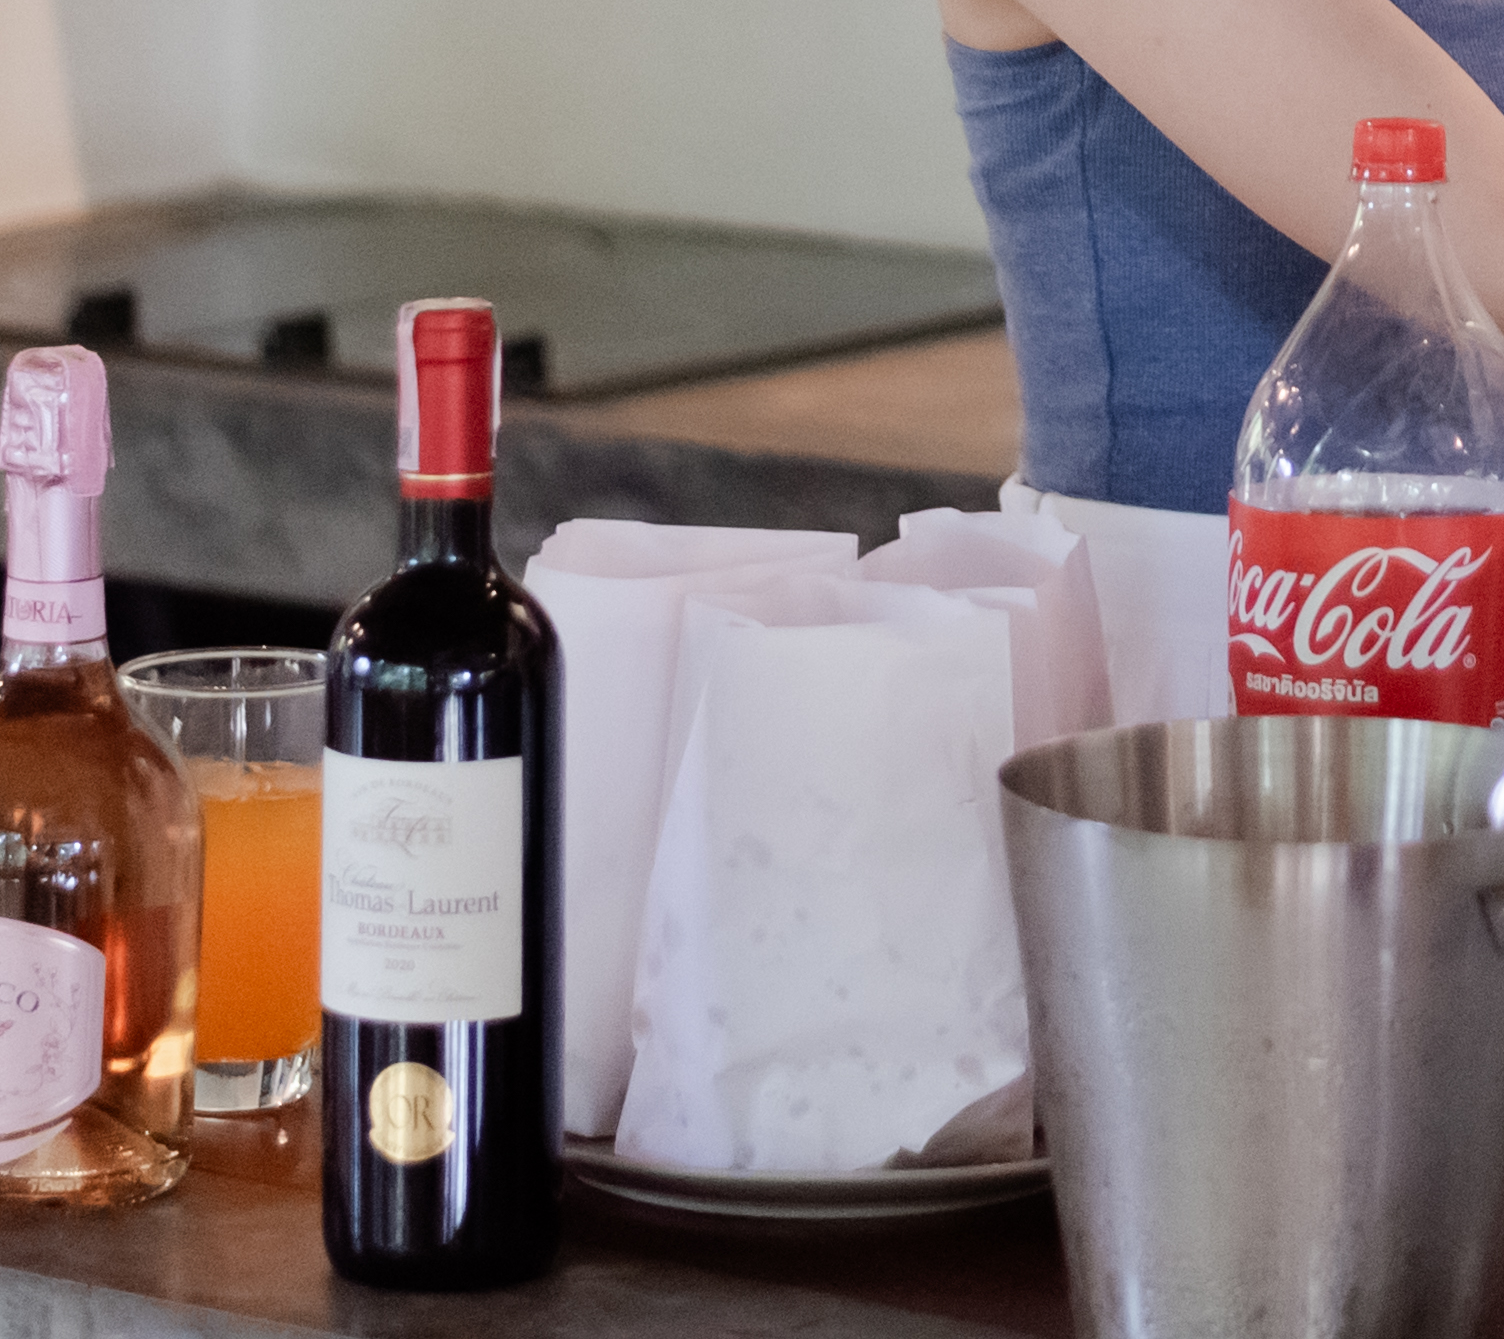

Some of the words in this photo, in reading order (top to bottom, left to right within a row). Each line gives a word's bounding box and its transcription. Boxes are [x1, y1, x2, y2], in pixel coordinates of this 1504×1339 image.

[328, 873, 395, 914] Thomas
[407, 889, 500, 916] Laurent
[357, 921, 446, 940] BORDEAUX
